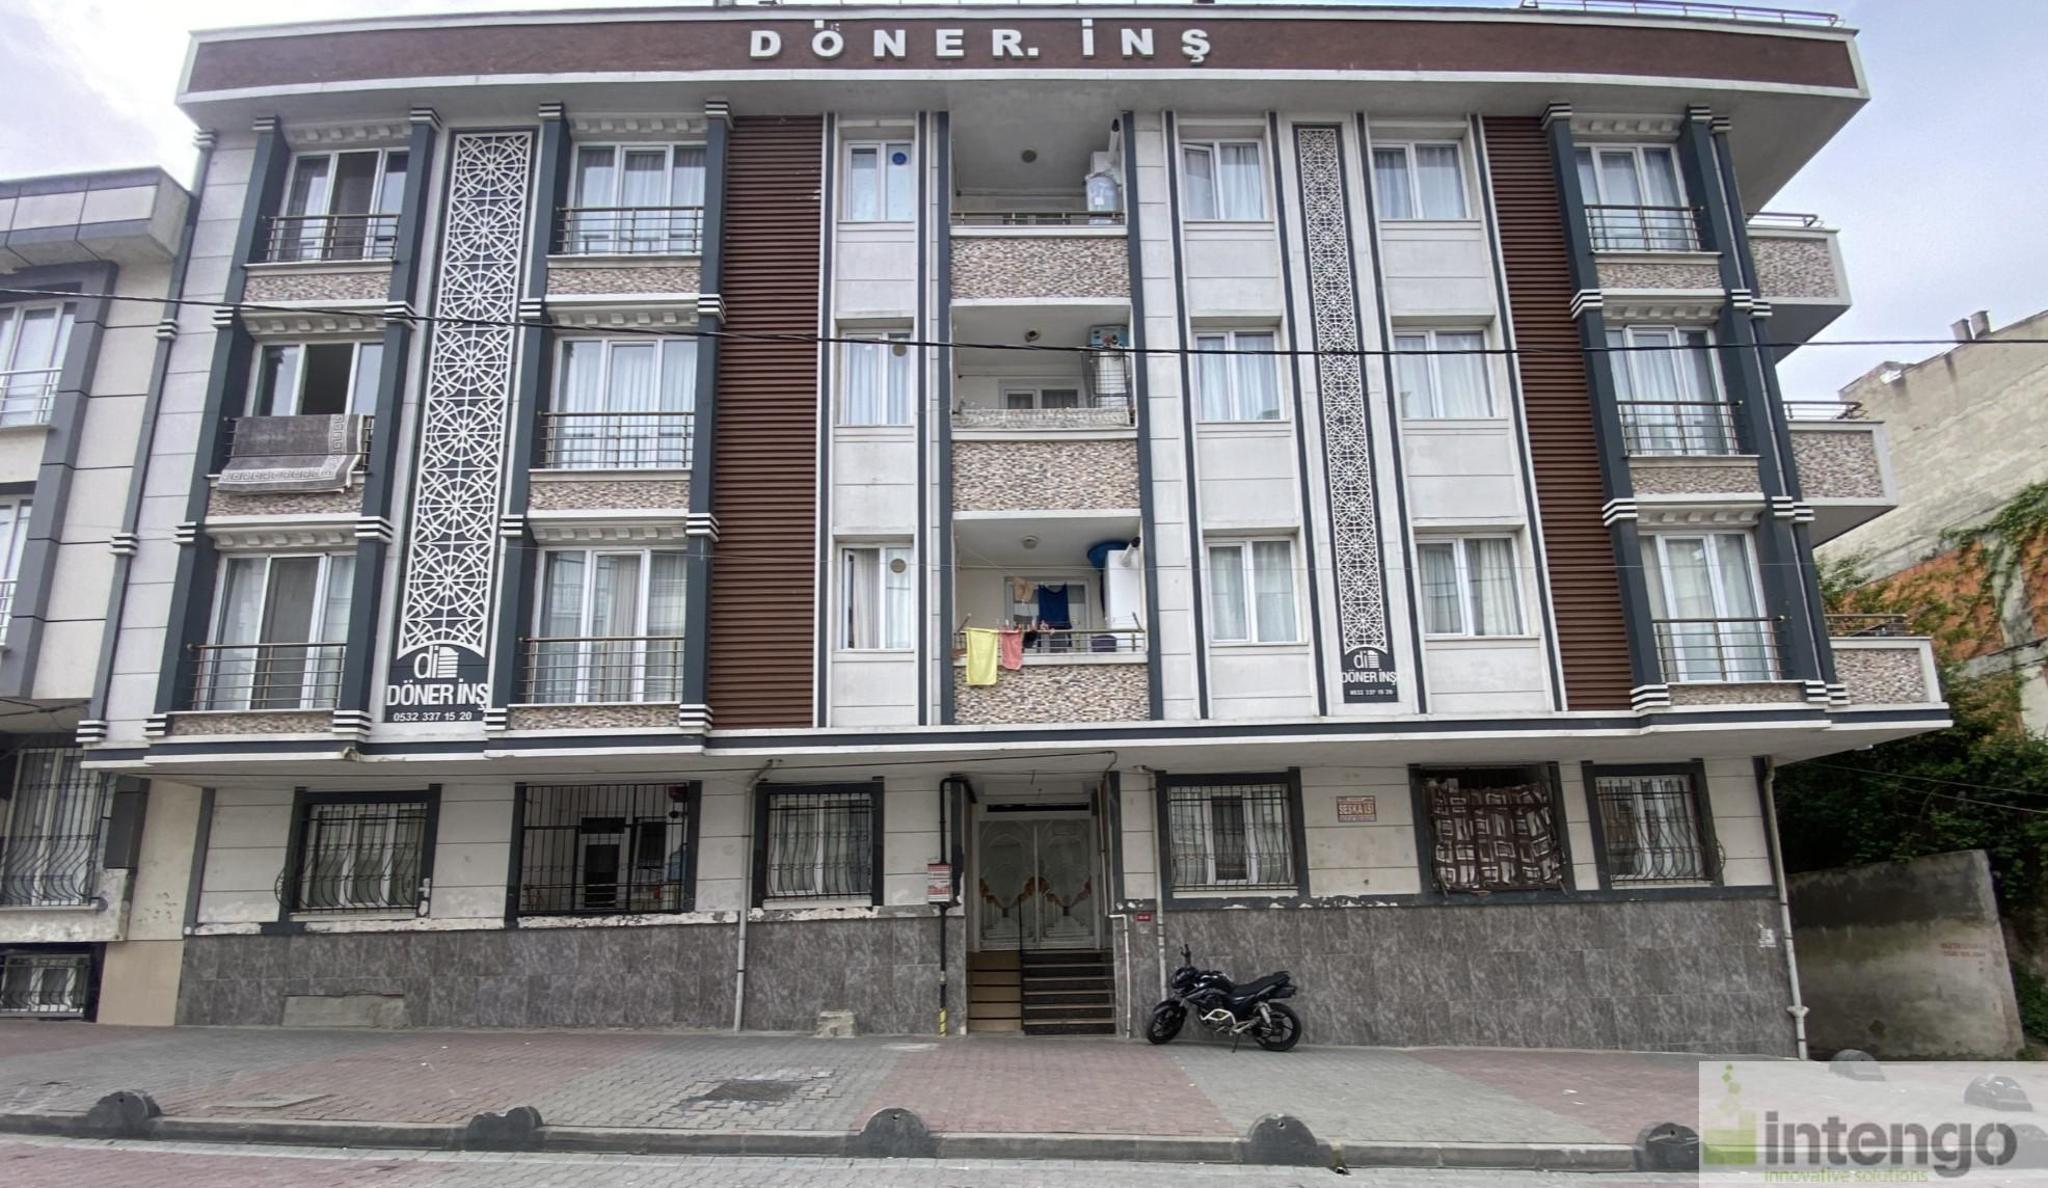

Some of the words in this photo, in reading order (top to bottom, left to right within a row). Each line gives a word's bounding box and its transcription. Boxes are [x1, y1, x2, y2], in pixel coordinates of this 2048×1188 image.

[1081, 19, 1211, 63] İNŞ
[1340, 669, 1378, 683] DÖNER
[386, 679, 455, 706] DÖNER
[456, 678, 489, 710] İNŞ
[393, 712, 419, 722] 0532
[422, 712, 441, 721] 337
[444, 712, 456, 721] 15
[460, 711, 473, 720] 20
